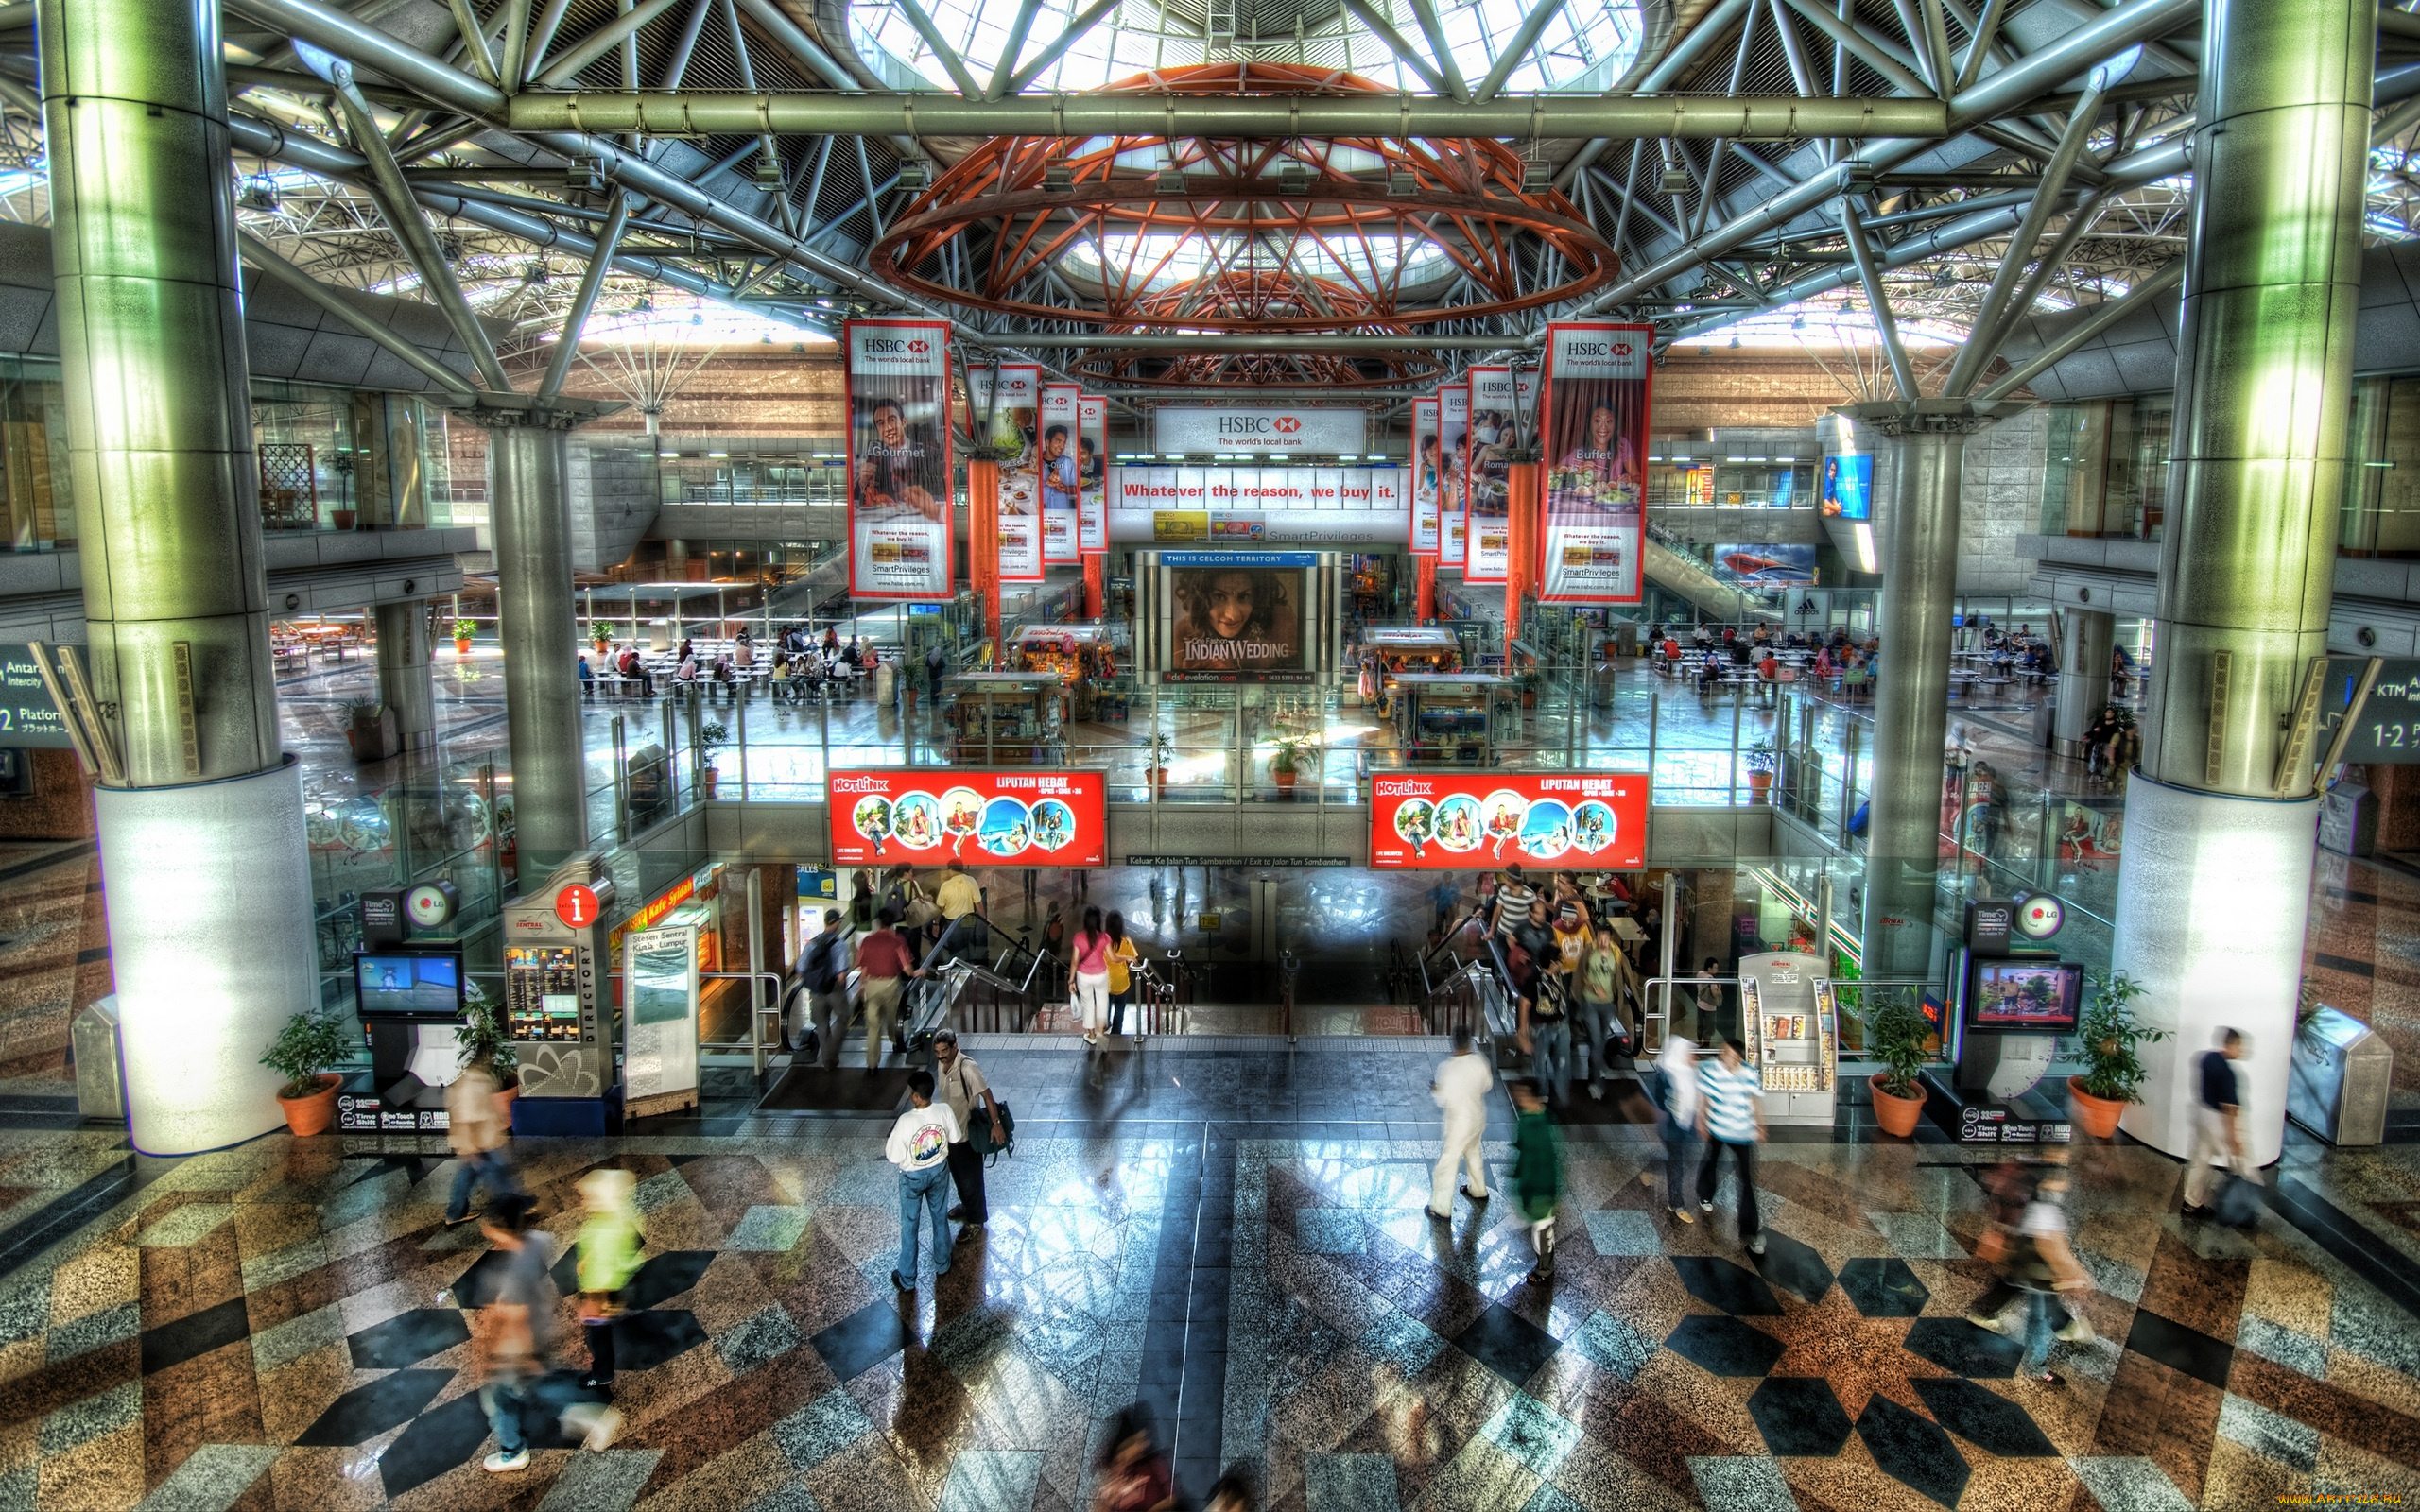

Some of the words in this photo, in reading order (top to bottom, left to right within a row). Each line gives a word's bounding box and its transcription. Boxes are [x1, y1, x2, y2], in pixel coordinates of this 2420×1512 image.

[865, 339, 905, 352] HSBC
[1568, 343, 1608, 356] HSBC
[1482, 383, 1511, 392] HSBC
[1042, 397, 1053, 405] BC
[1450, 398, 1467, 406] HSB
[1219, 417, 1270, 433] HSBC
[873, 446, 925, 458] Gourmet
[1576, 449, 1612, 460] Buffet
[998, 459, 1021, 468] press
[1124, 484, 1204, 497] Whatever
[1212, 485, 1238, 498] the
[1243, 486, 1304, 499] reason,
[1311, 487, 1335, 498] we
[1340, 485, 1370, 500] buy
[1378, 485, 1395, 498] it.
[1270, 531, 1373, 542] SmartPrivileges
[872, 564, 930, 575] SmartPrivileges
[1563, 568, 1620, 577] SmartPrivileges
[1184, 640, 1230, 661] INDIAN
[1229, 639, 1289, 659] WEDDING
[1166, 672, 1236, 681] AdsRevelation.com
[8, 677, 42, 689] Intercity
[2377, 684, 2406, 696] KTM
[2374, 724, 2404, 747] 1-2
[996, 777, 1036, 788] LIPUTAN
[1038, 777, 1068, 788] HEBAT
[1540, 779, 1580, 790] LIPUTAN
[1582, 779, 1613, 790] HEBAT
[1167, 857, 1183, 866] Jalan
[1272, 858, 1289, 867] Jalan
[1305, 858, 1347, 867] Sambanthan
[648, 898, 667, 919] Kafe
[667, 880, 692, 906] Syidah
[633, 934, 658, 943] Stesen
[662, 929, 687, 939] Sentral
[633, 942, 653, 952] Kuala
[659, 939, 687, 948] Lumpur
[581, 946, 595, 1042] DIRECTORY
